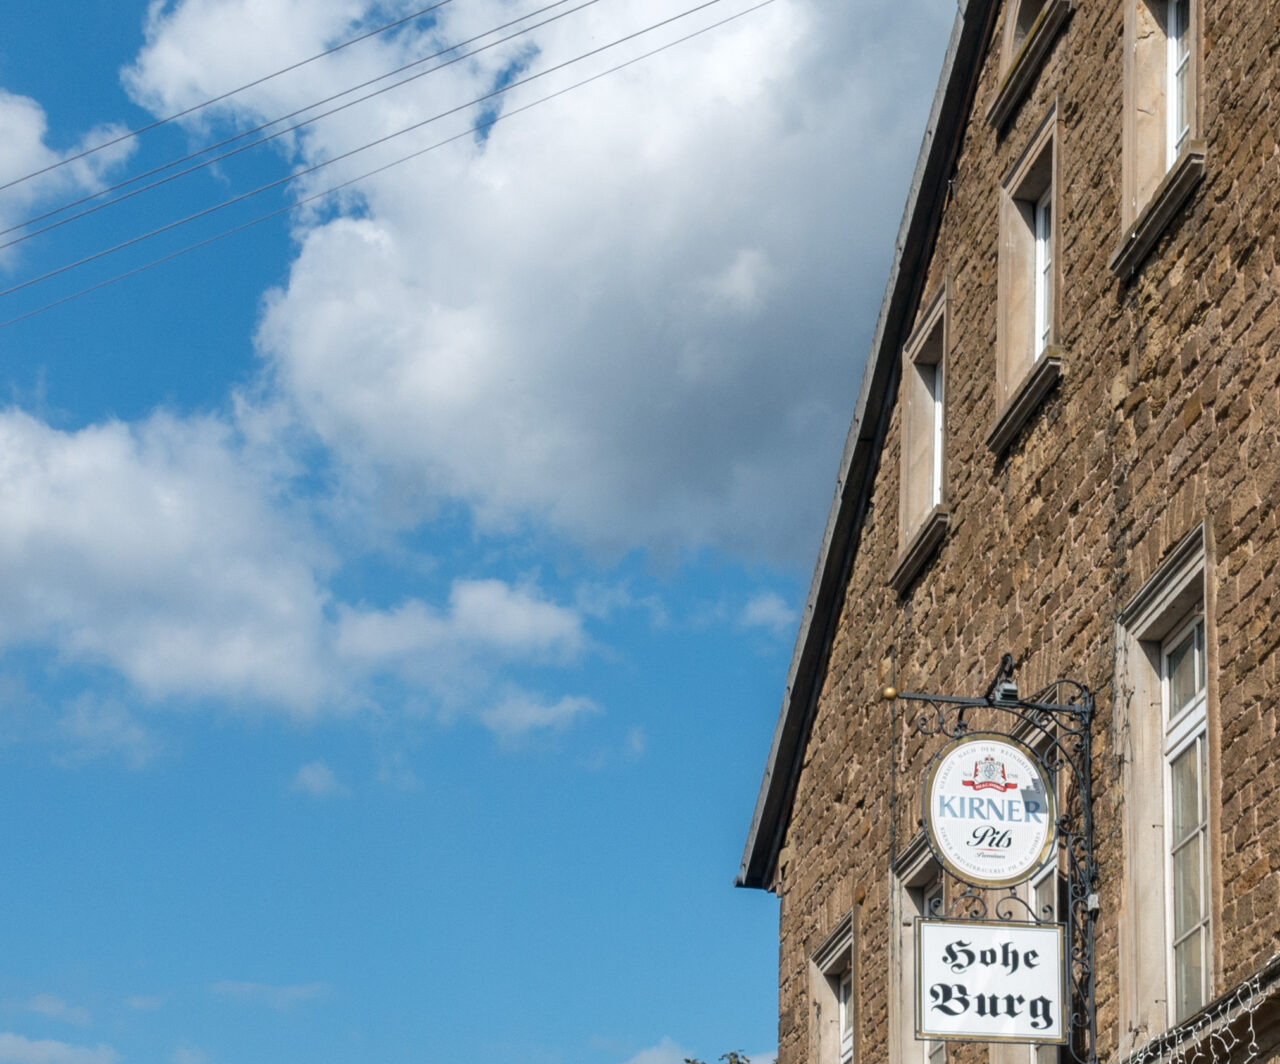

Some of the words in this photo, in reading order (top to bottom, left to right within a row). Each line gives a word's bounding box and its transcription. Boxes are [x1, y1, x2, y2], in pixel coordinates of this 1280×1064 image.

[939, 794, 1042, 824] KIRNER
[966, 825, 1012, 848] Pils
[942, 940, 1040, 976] Hohe
[930, 983, 1053, 1030] Burg
